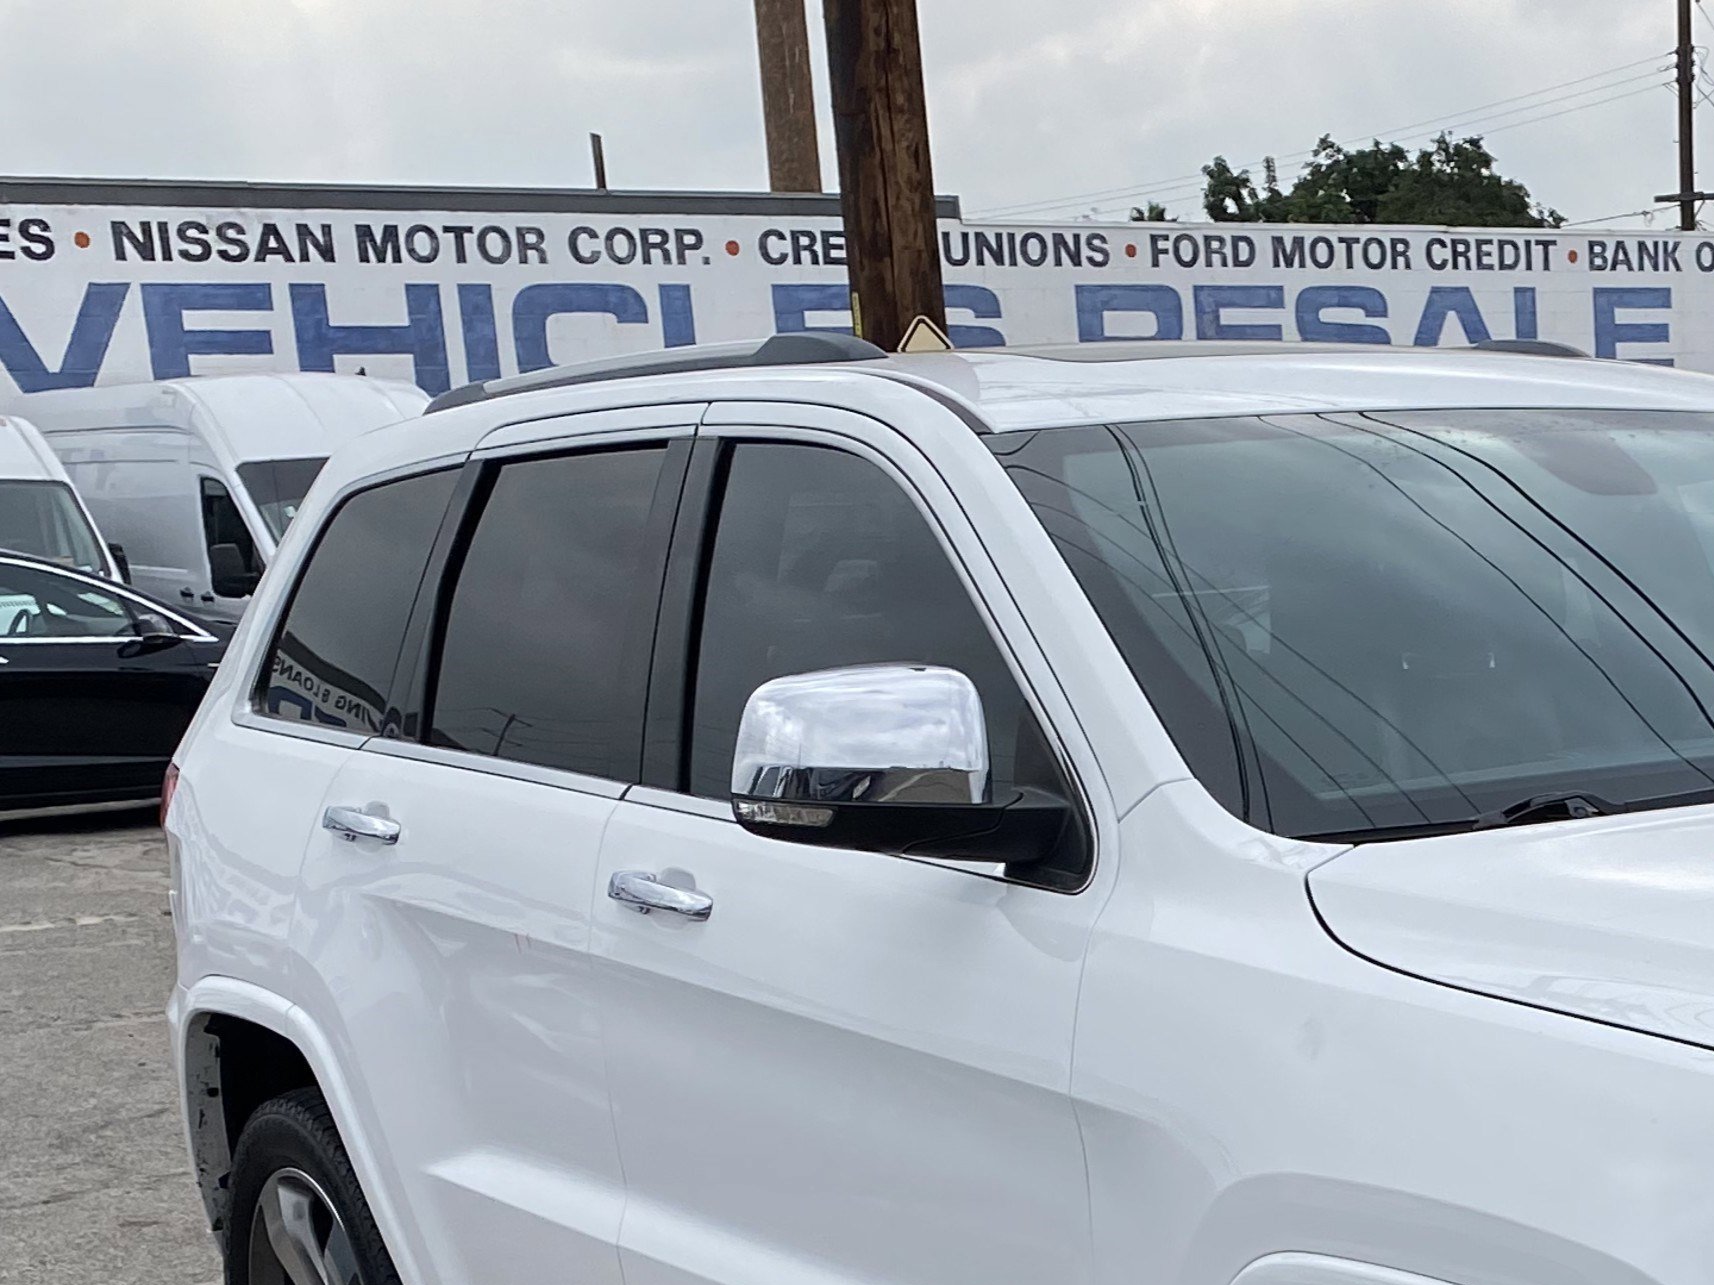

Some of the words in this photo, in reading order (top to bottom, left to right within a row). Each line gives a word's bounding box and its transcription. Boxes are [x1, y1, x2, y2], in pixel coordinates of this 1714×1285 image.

[110, 220, 334, 265] NISSAN
[358, 224, 548, 266] MOTOR
[567, 227, 712, 267] CORP.
[759, 229, 849, 267] CRE
[943, 231, 1111, 269] UNIONS
[1150, 233, 1257, 270] FORD
[1272, 235, 1413, 271] MOTOR
[1425, 237, 1557, 272] CREDIT
[1589, 240, 1682, 273] BANK
